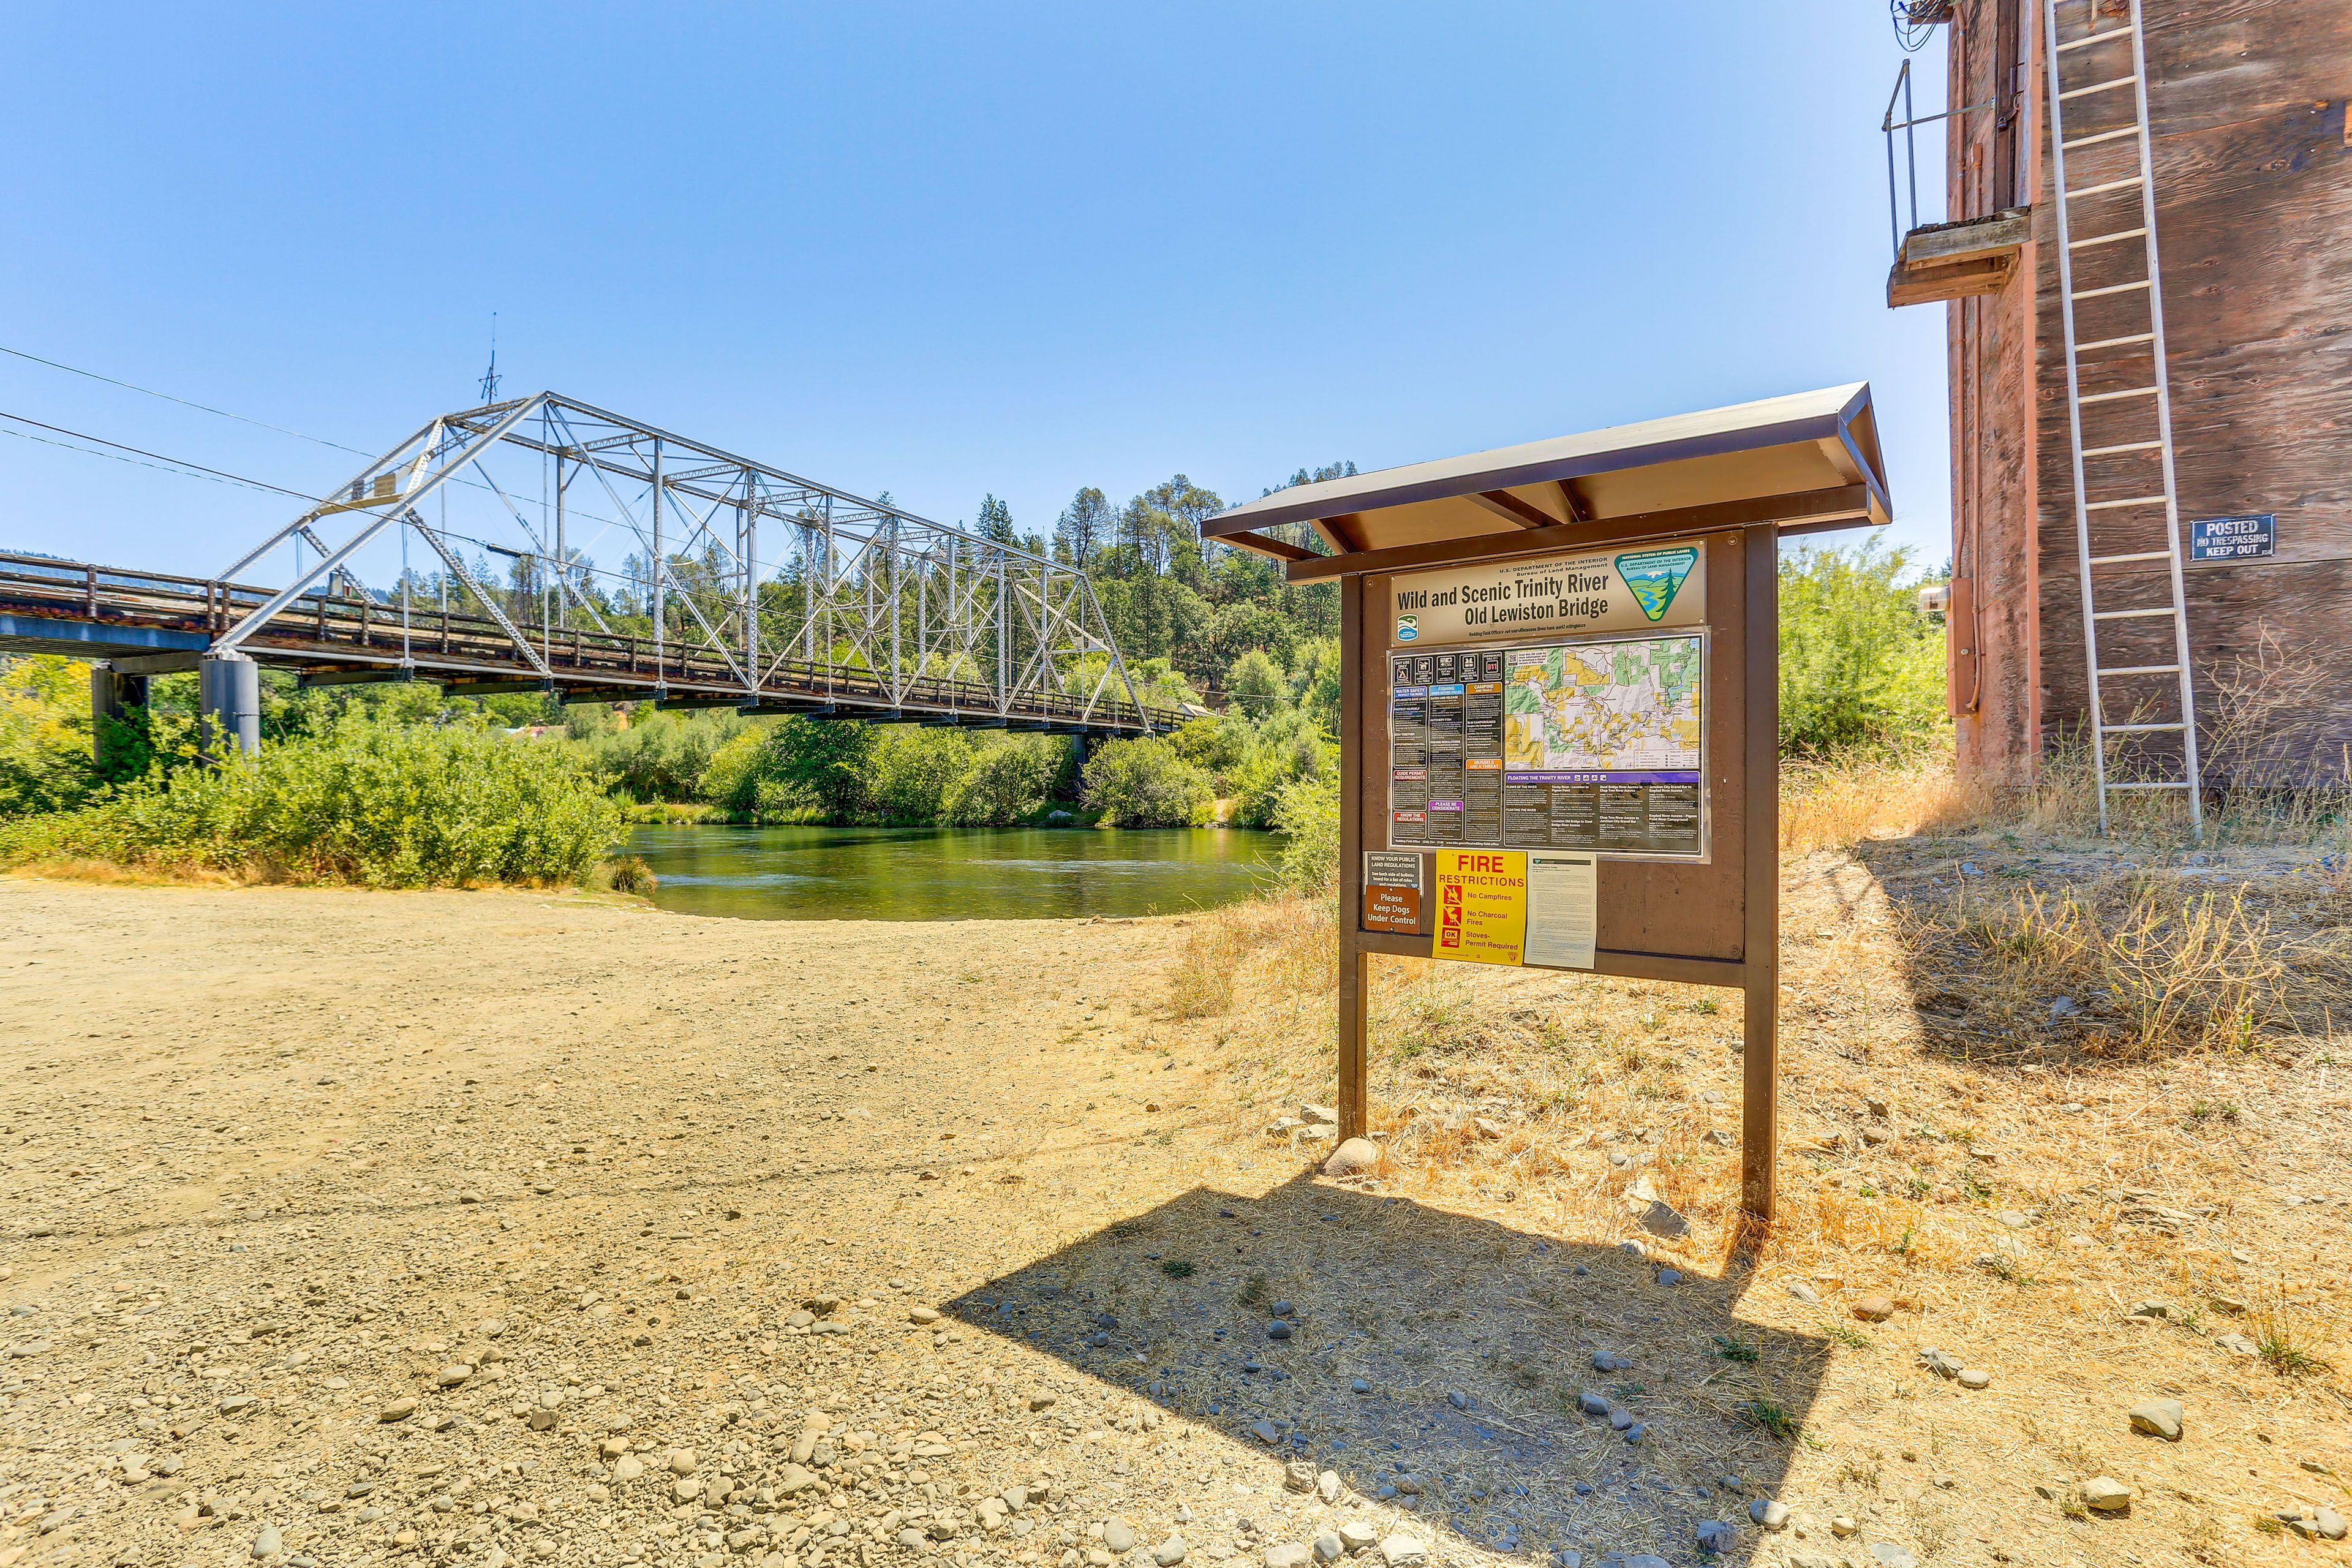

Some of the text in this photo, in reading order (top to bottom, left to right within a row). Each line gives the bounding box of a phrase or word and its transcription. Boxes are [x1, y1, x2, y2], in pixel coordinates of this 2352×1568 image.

[2206, 520, 2258, 537] POSTED
[2196, 533, 2269, 547] NO TRESPASSING
[2206, 546, 2234, 557] KEEP
[2237, 545, 2259, 554] OUT
[1513, 564, 1552, 572] DEPARTMENT
[1566, 563, 1608, 571] Management
[1398, 573, 1608, 610] Wild and Scenic Trinity River
[1465, 597, 1608, 625] Old Lewiston Bridge
[1458, 855, 1504, 873] FIRE
[1439, 875, 1524, 887] RESTRICTIONS
[1381, 894, 1403, 902] Please
[1373, 903, 1410, 915] Keep Dogs
[1368, 913, 1416, 925] Under Control
